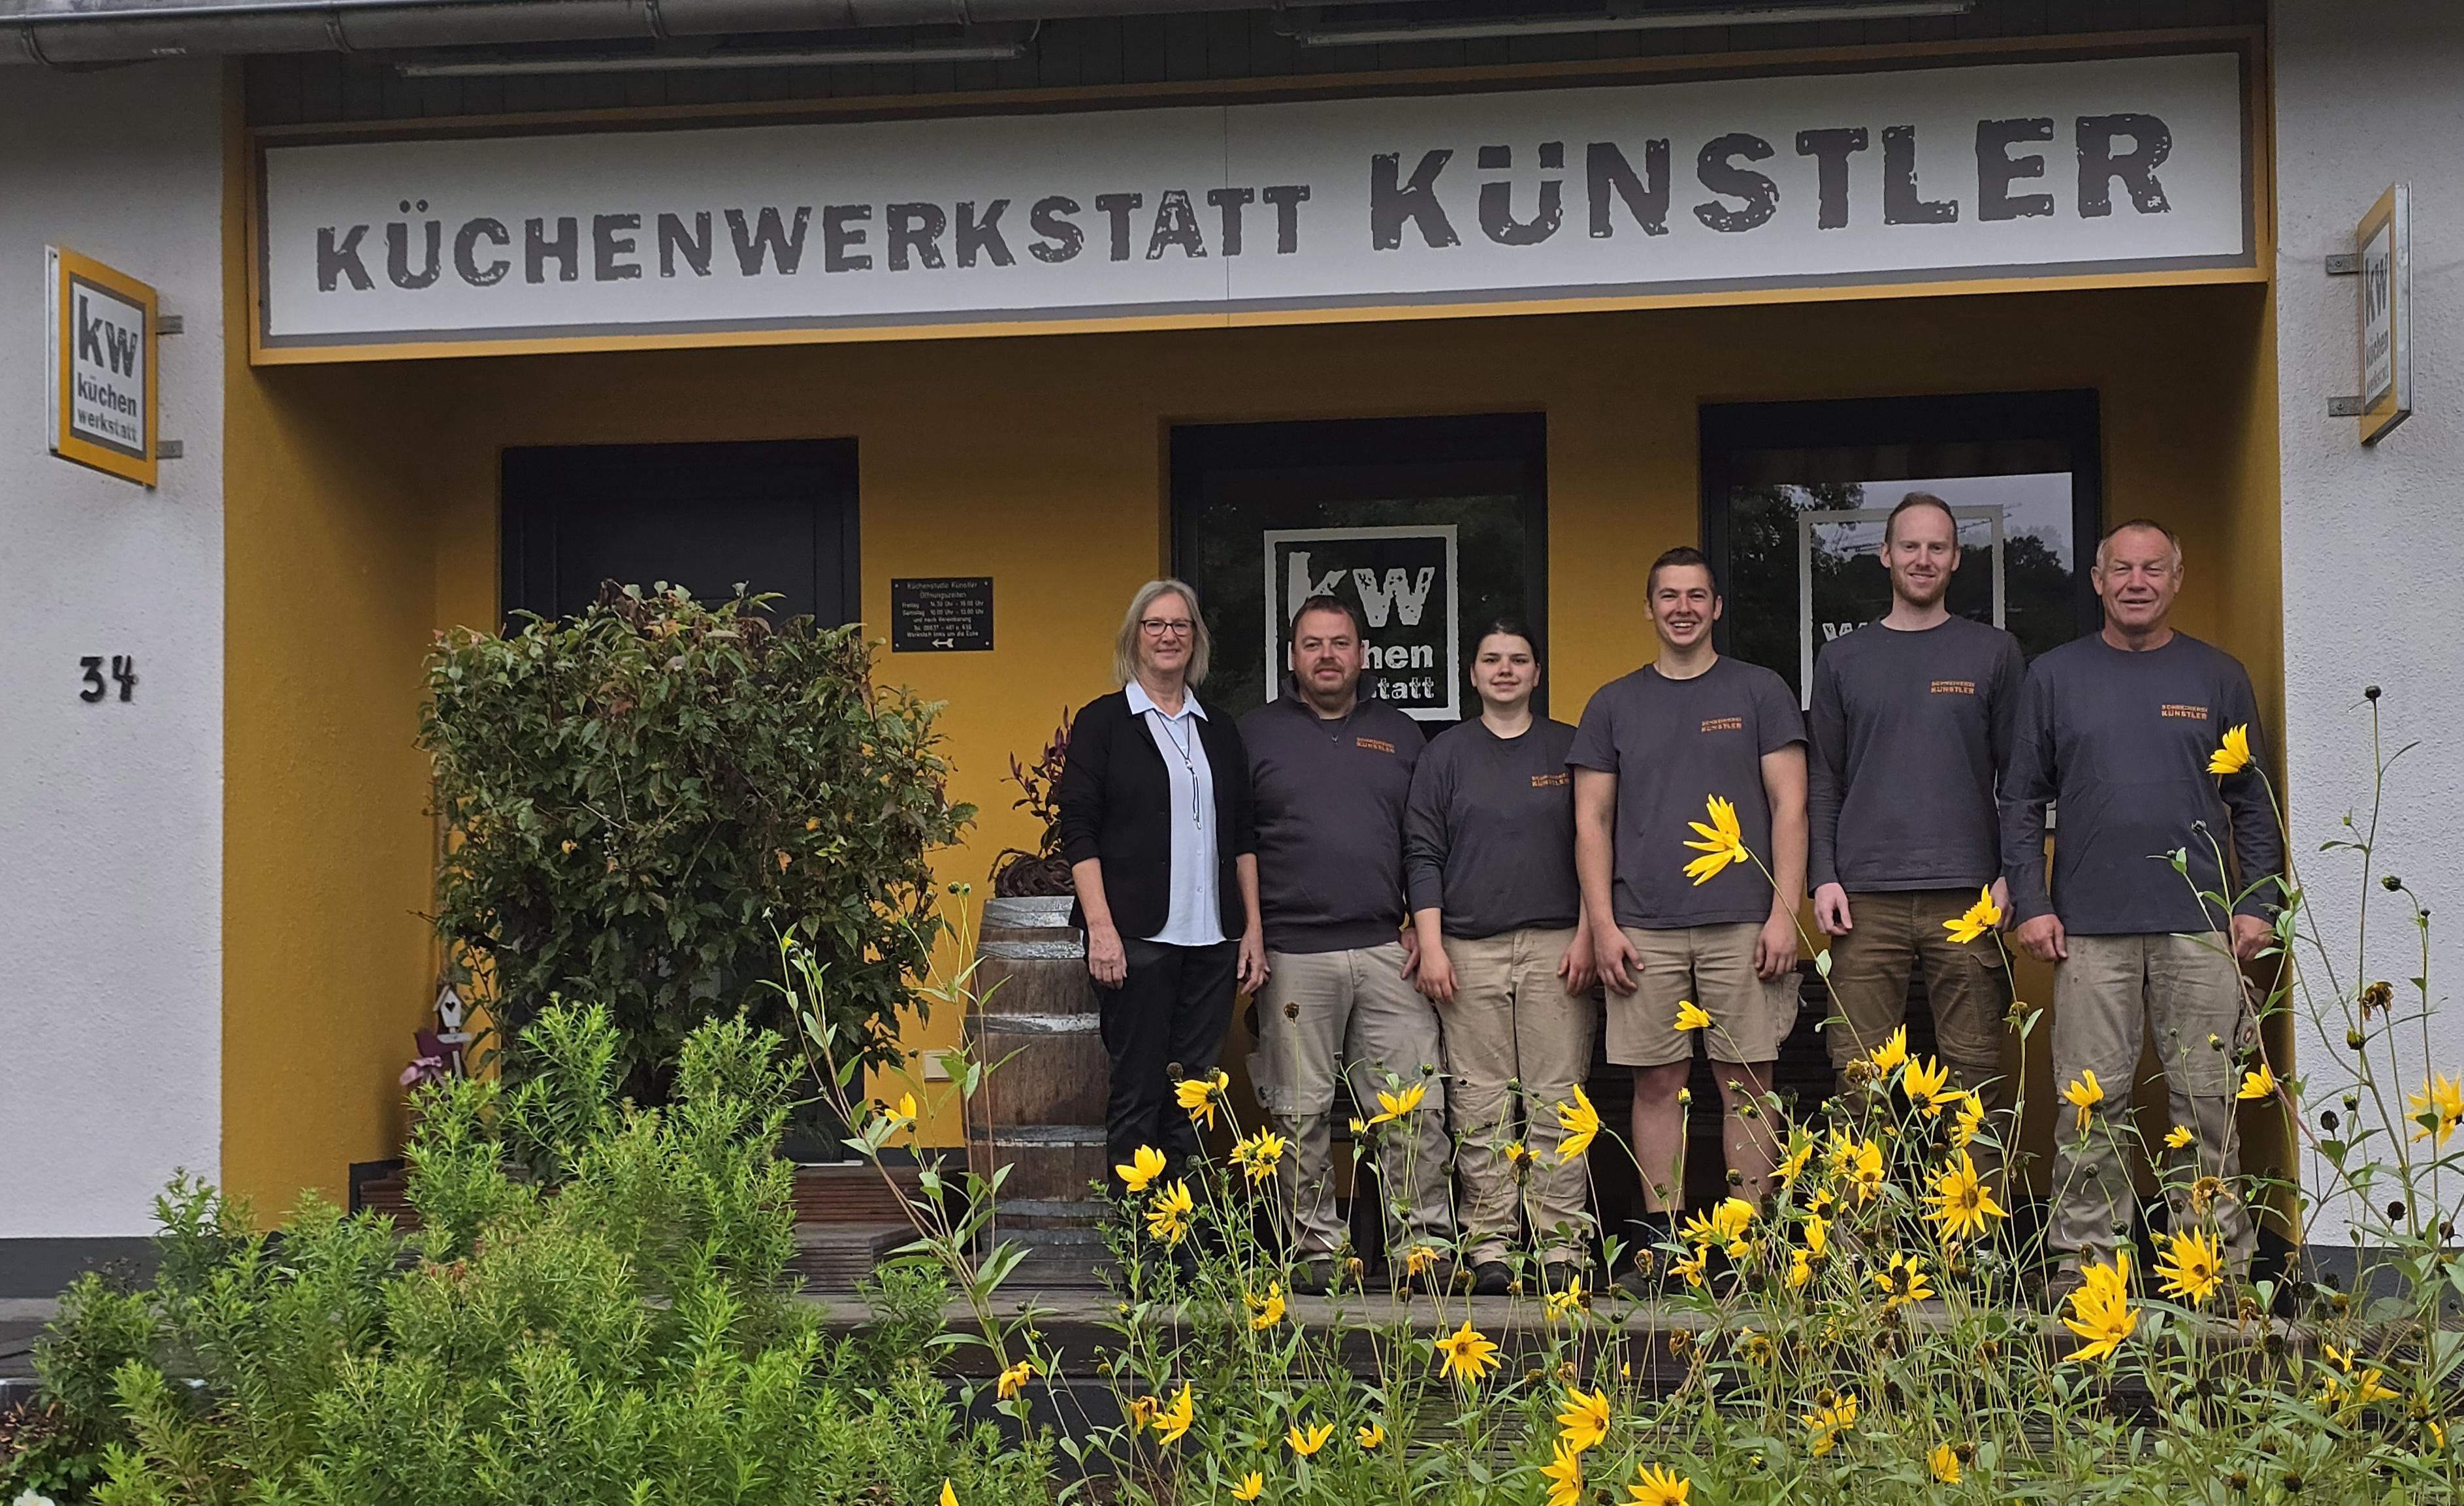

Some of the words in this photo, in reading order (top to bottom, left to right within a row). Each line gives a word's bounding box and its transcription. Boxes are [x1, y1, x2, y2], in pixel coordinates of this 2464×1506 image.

[317, 185, 1311, 291] KÜCHENWERKSTATT
[1370, 113, 2173, 251] KÜNSTLER
[79, 294, 138, 378] kw
[77, 372, 137, 418] küchen
[77, 408, 137, 443] werkstatt
[80, 655, 138, 703] 34
